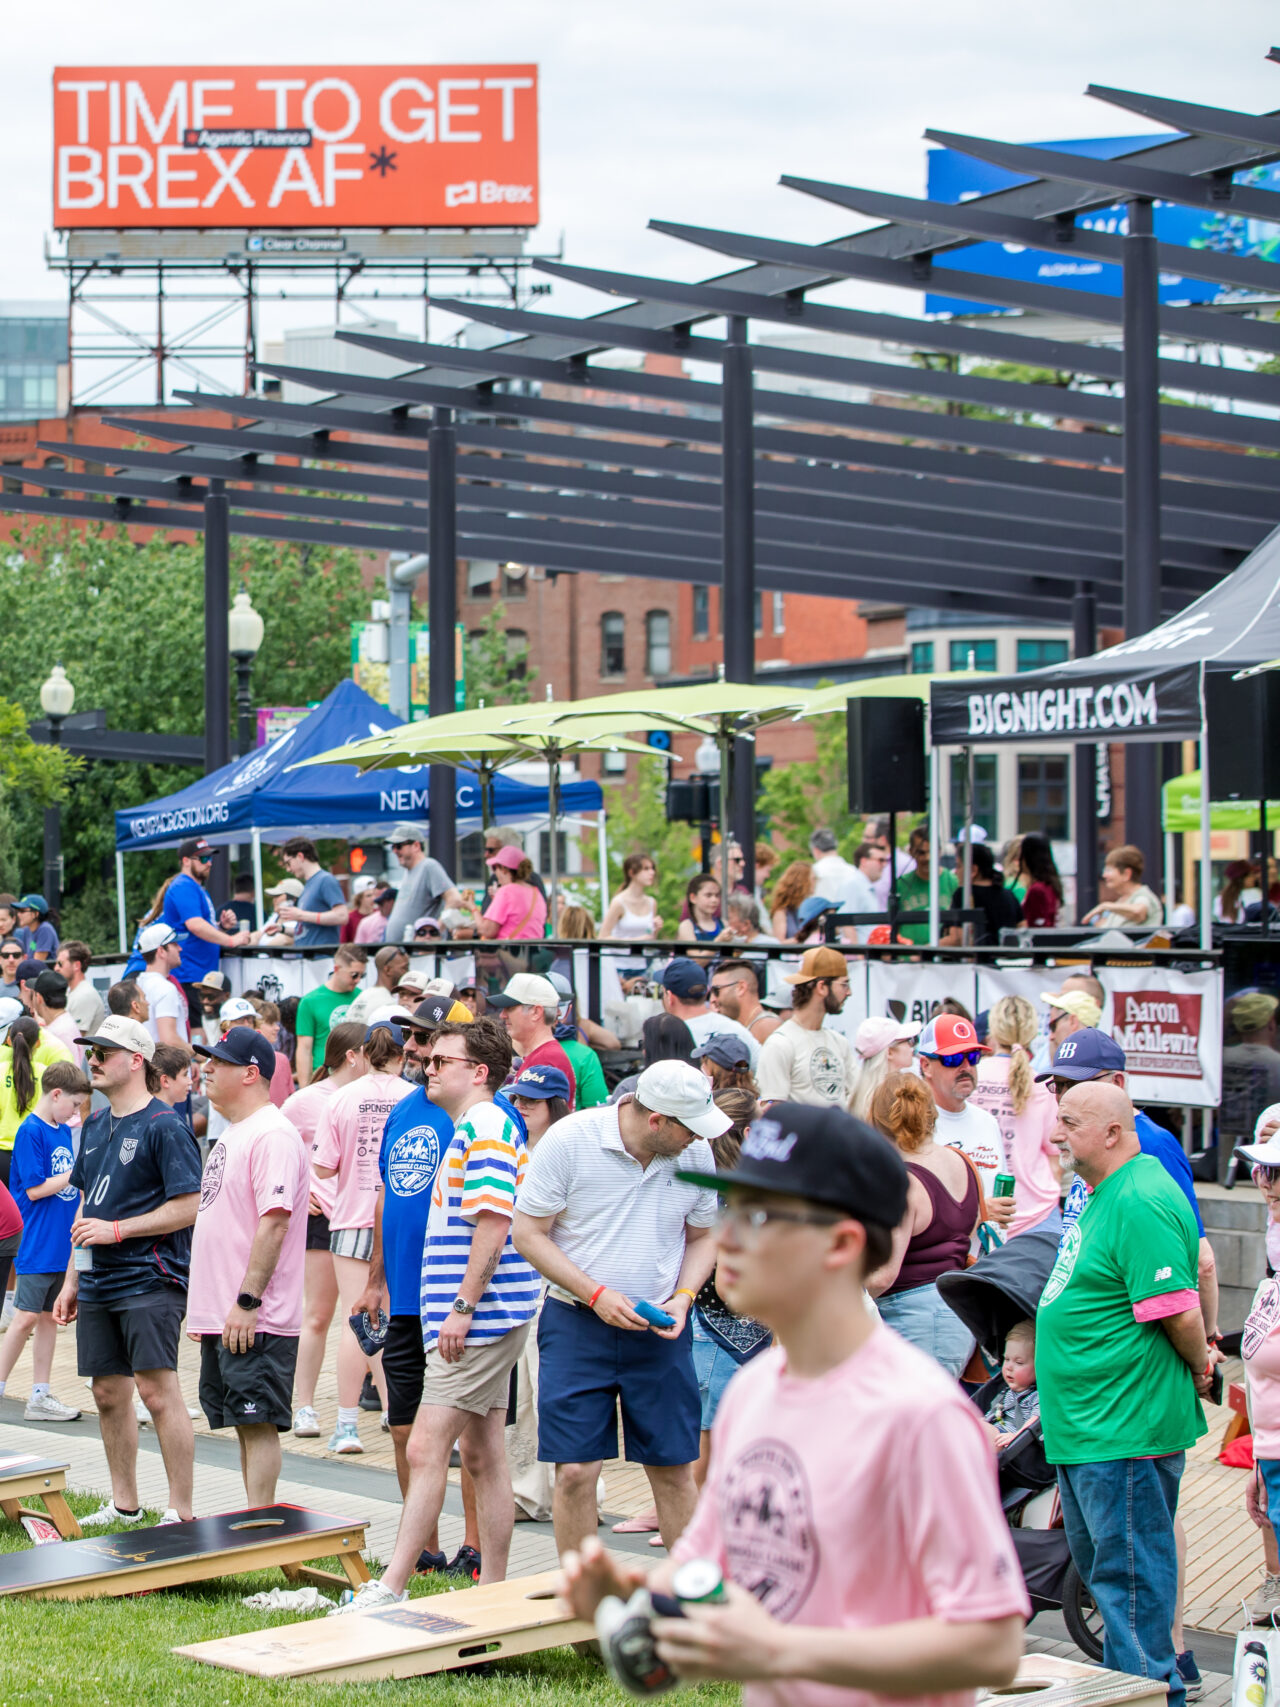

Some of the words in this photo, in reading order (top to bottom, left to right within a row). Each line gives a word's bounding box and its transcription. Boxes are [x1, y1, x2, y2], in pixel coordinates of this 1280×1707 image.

[256, 78, 361, 143] TO
[379, 77, 533, 143] GET
[197, 129, 250, 148] Agentic
[253, 129, 310, 146] Finance
[58, 144, 256, 208] BREX
[481, 182, 533, 203] Brex
[968, 681, 1158, 735] BIGNIGHT.COM
[1125, 996, 1180, 1024] Aaron
[414, 1163, 434, 1173] CLASSIC
[86, 1174, 111, 1206] 10
